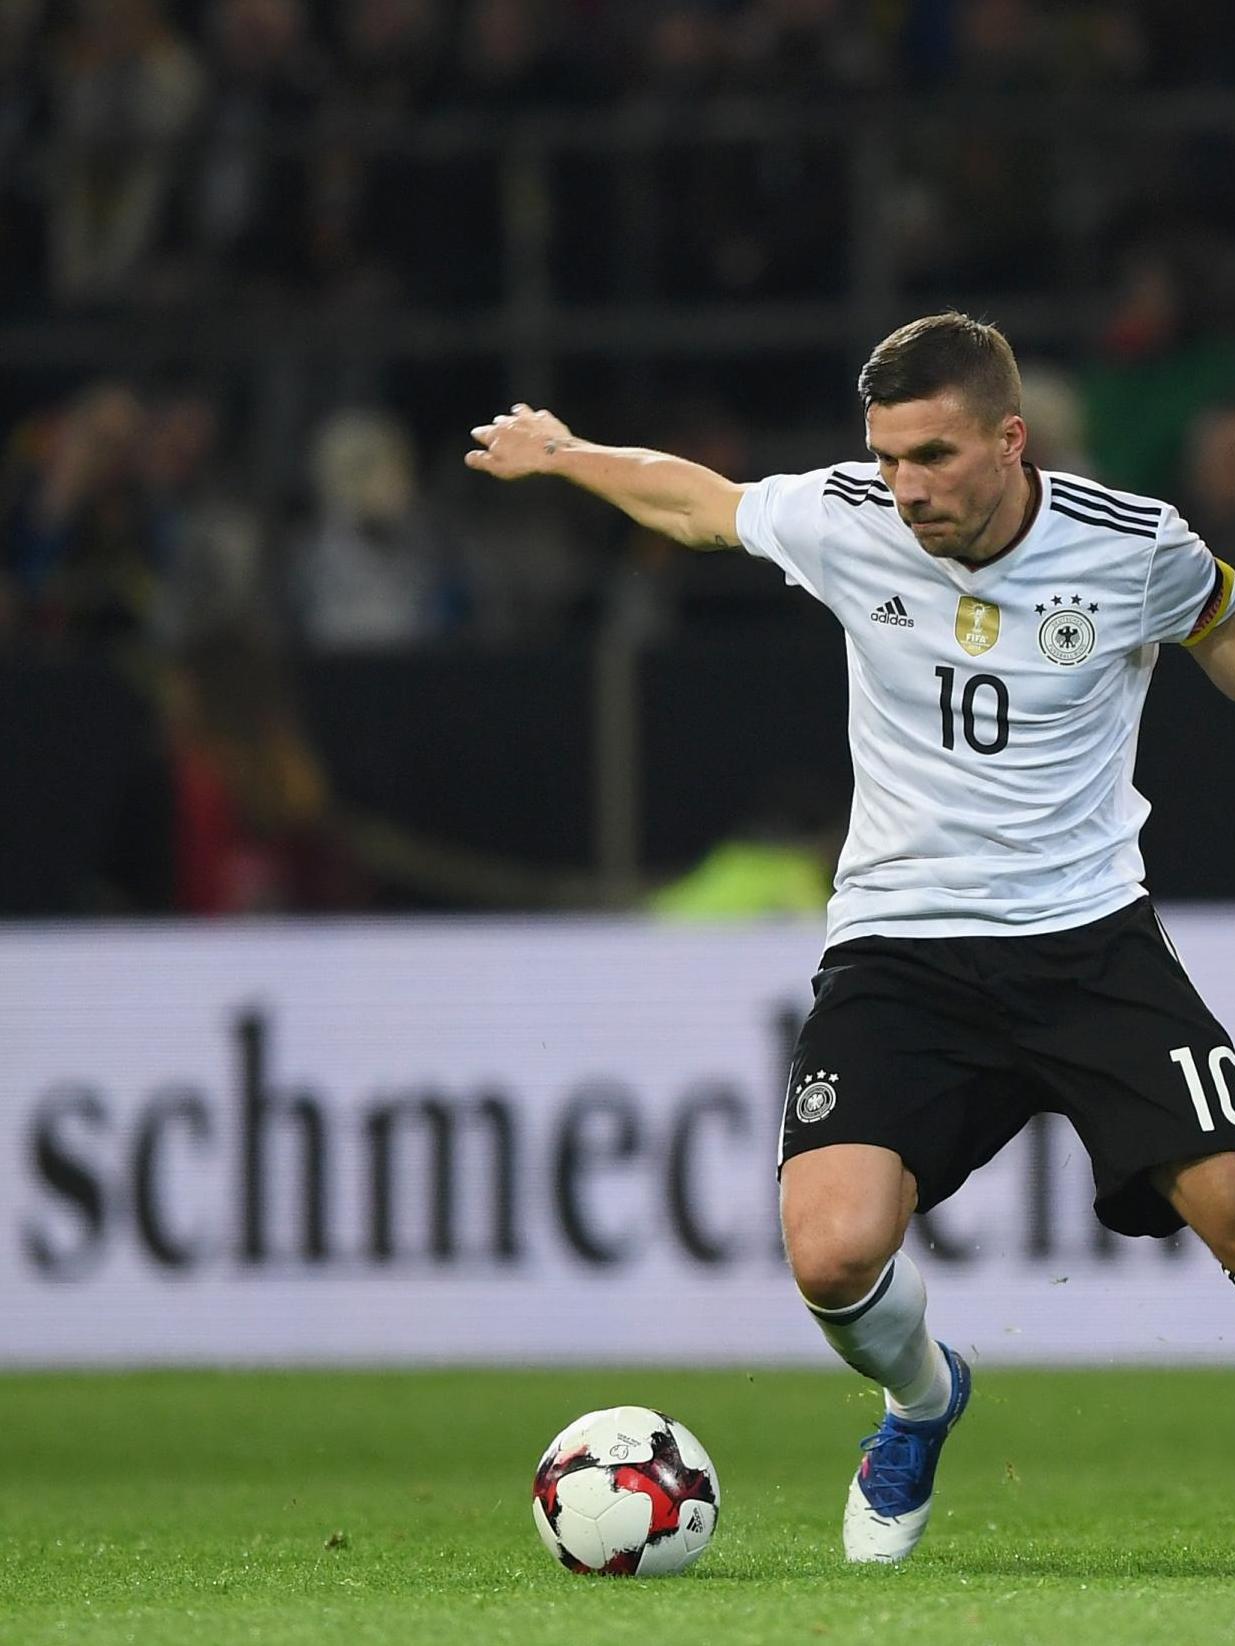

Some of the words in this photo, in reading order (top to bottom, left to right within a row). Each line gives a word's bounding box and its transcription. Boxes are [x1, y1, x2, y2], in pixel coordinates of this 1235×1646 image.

[870, 612, 914, 628] adidas
[966, 633, 986, 643] FIFA
[935, 665, 1010, 755] 10
